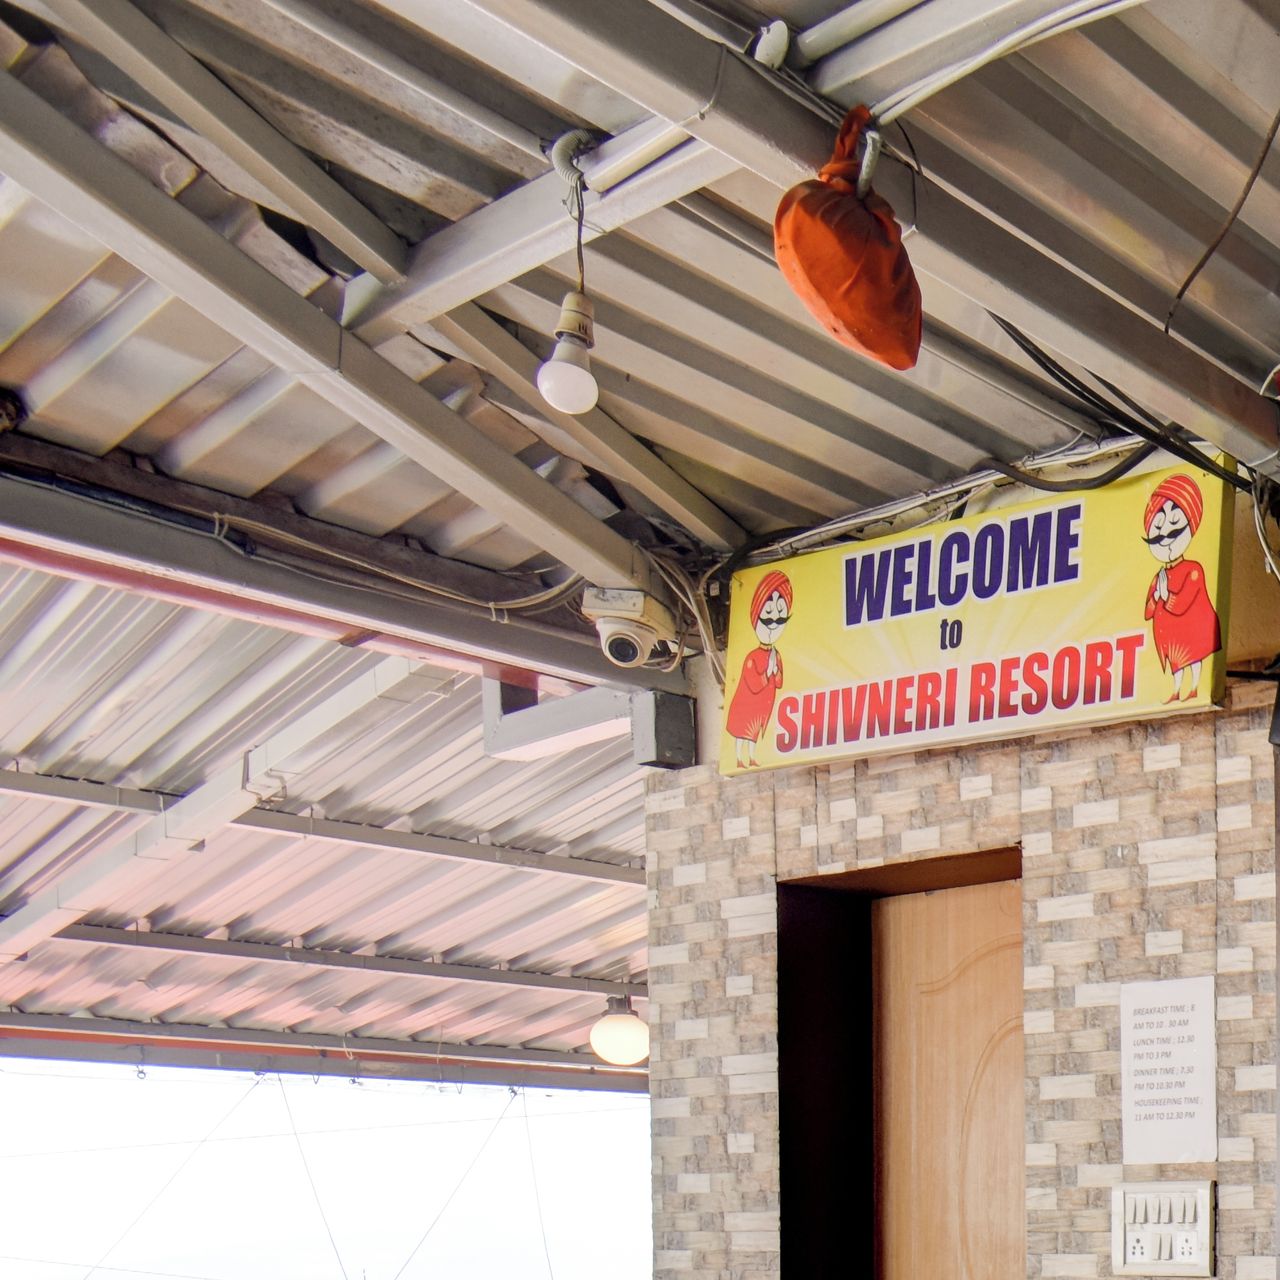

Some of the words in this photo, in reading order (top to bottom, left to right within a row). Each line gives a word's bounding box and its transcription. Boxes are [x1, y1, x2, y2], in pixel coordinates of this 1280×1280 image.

[844, 503, 1082, 627] WELCOME
[940, 618, 963, 650] to
[776, 668, 958, 753] SHIVNERI
[968, 633, 1145, 724] RESORT
[1132, 1006, 1169, 1016] BREAKFAST
[1169, 1004, 1186, 1013] TIME
[1133, 1038, 1155, 1047] LUNCH
[1156, 1036, 1172, 1045] TIME
[1133, 1068, 1158, 1077] DINNER
[1159, 1066, 1175, 1075] TIME
[1183, 1096, 1200, 1105] TIME
